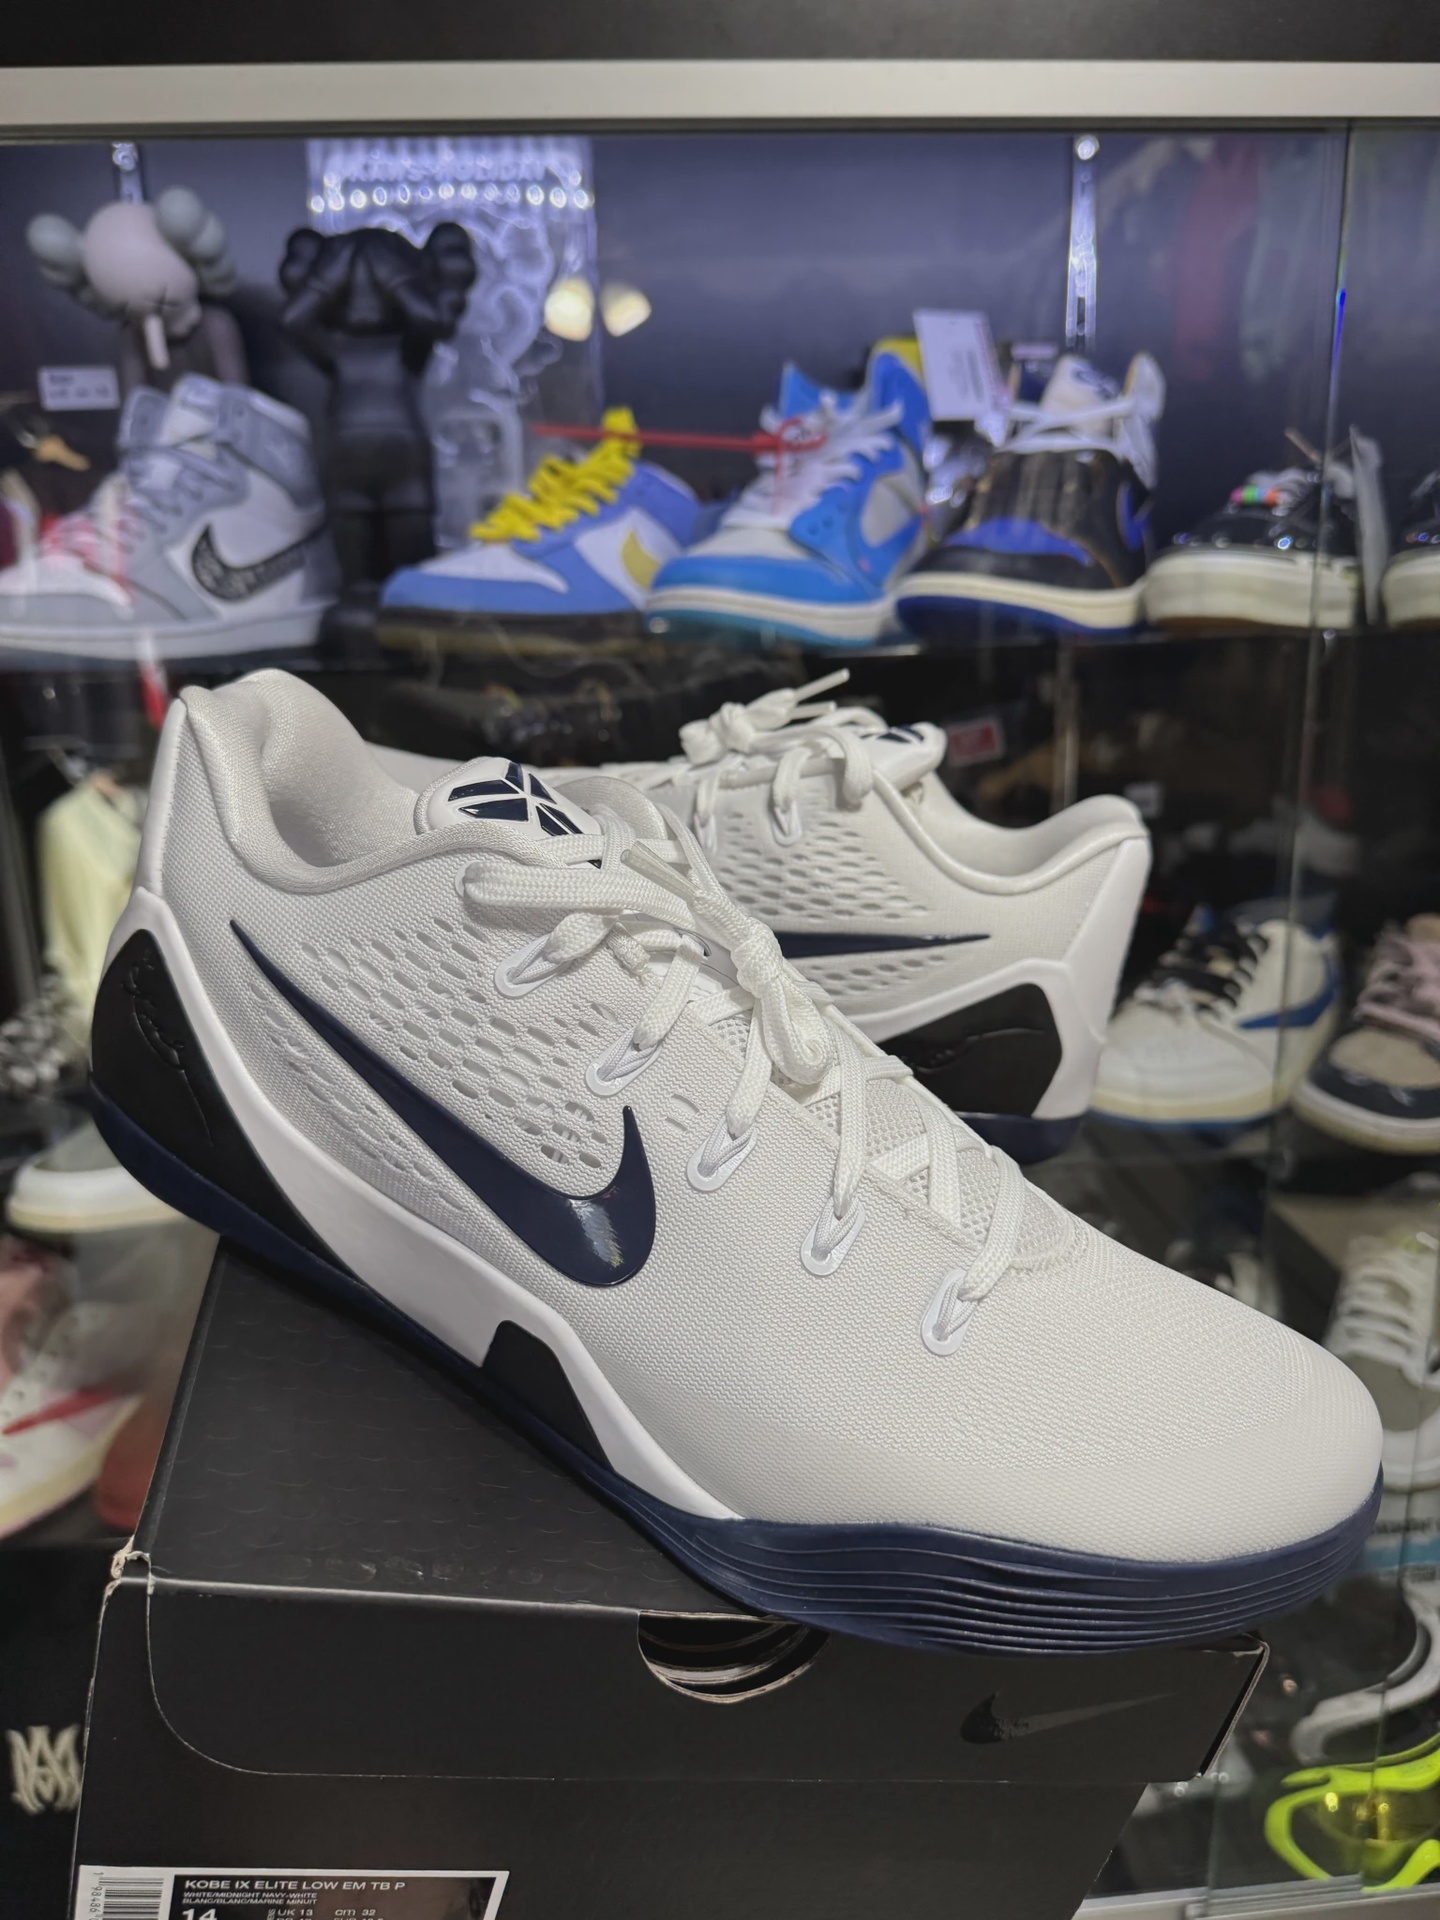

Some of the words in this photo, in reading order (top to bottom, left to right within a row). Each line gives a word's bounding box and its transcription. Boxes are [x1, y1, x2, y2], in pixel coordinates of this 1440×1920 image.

[185, 1879, 231, 1889] KOBE
[234, 1880, 251, 1889] IX
[254, 1880, 299, 1890] ELITE
[302, 1881, 339, 1890] LOW
[342, 1881, 367, 1890] EM
[371, 1881, 391, 1891] TB
[394, 1882, 406, 1891] P
[88, 1885, 102, 1913] 98486
[277, 1908, 296, 1916] UK
[300, 1908, 314, 1916] 13
